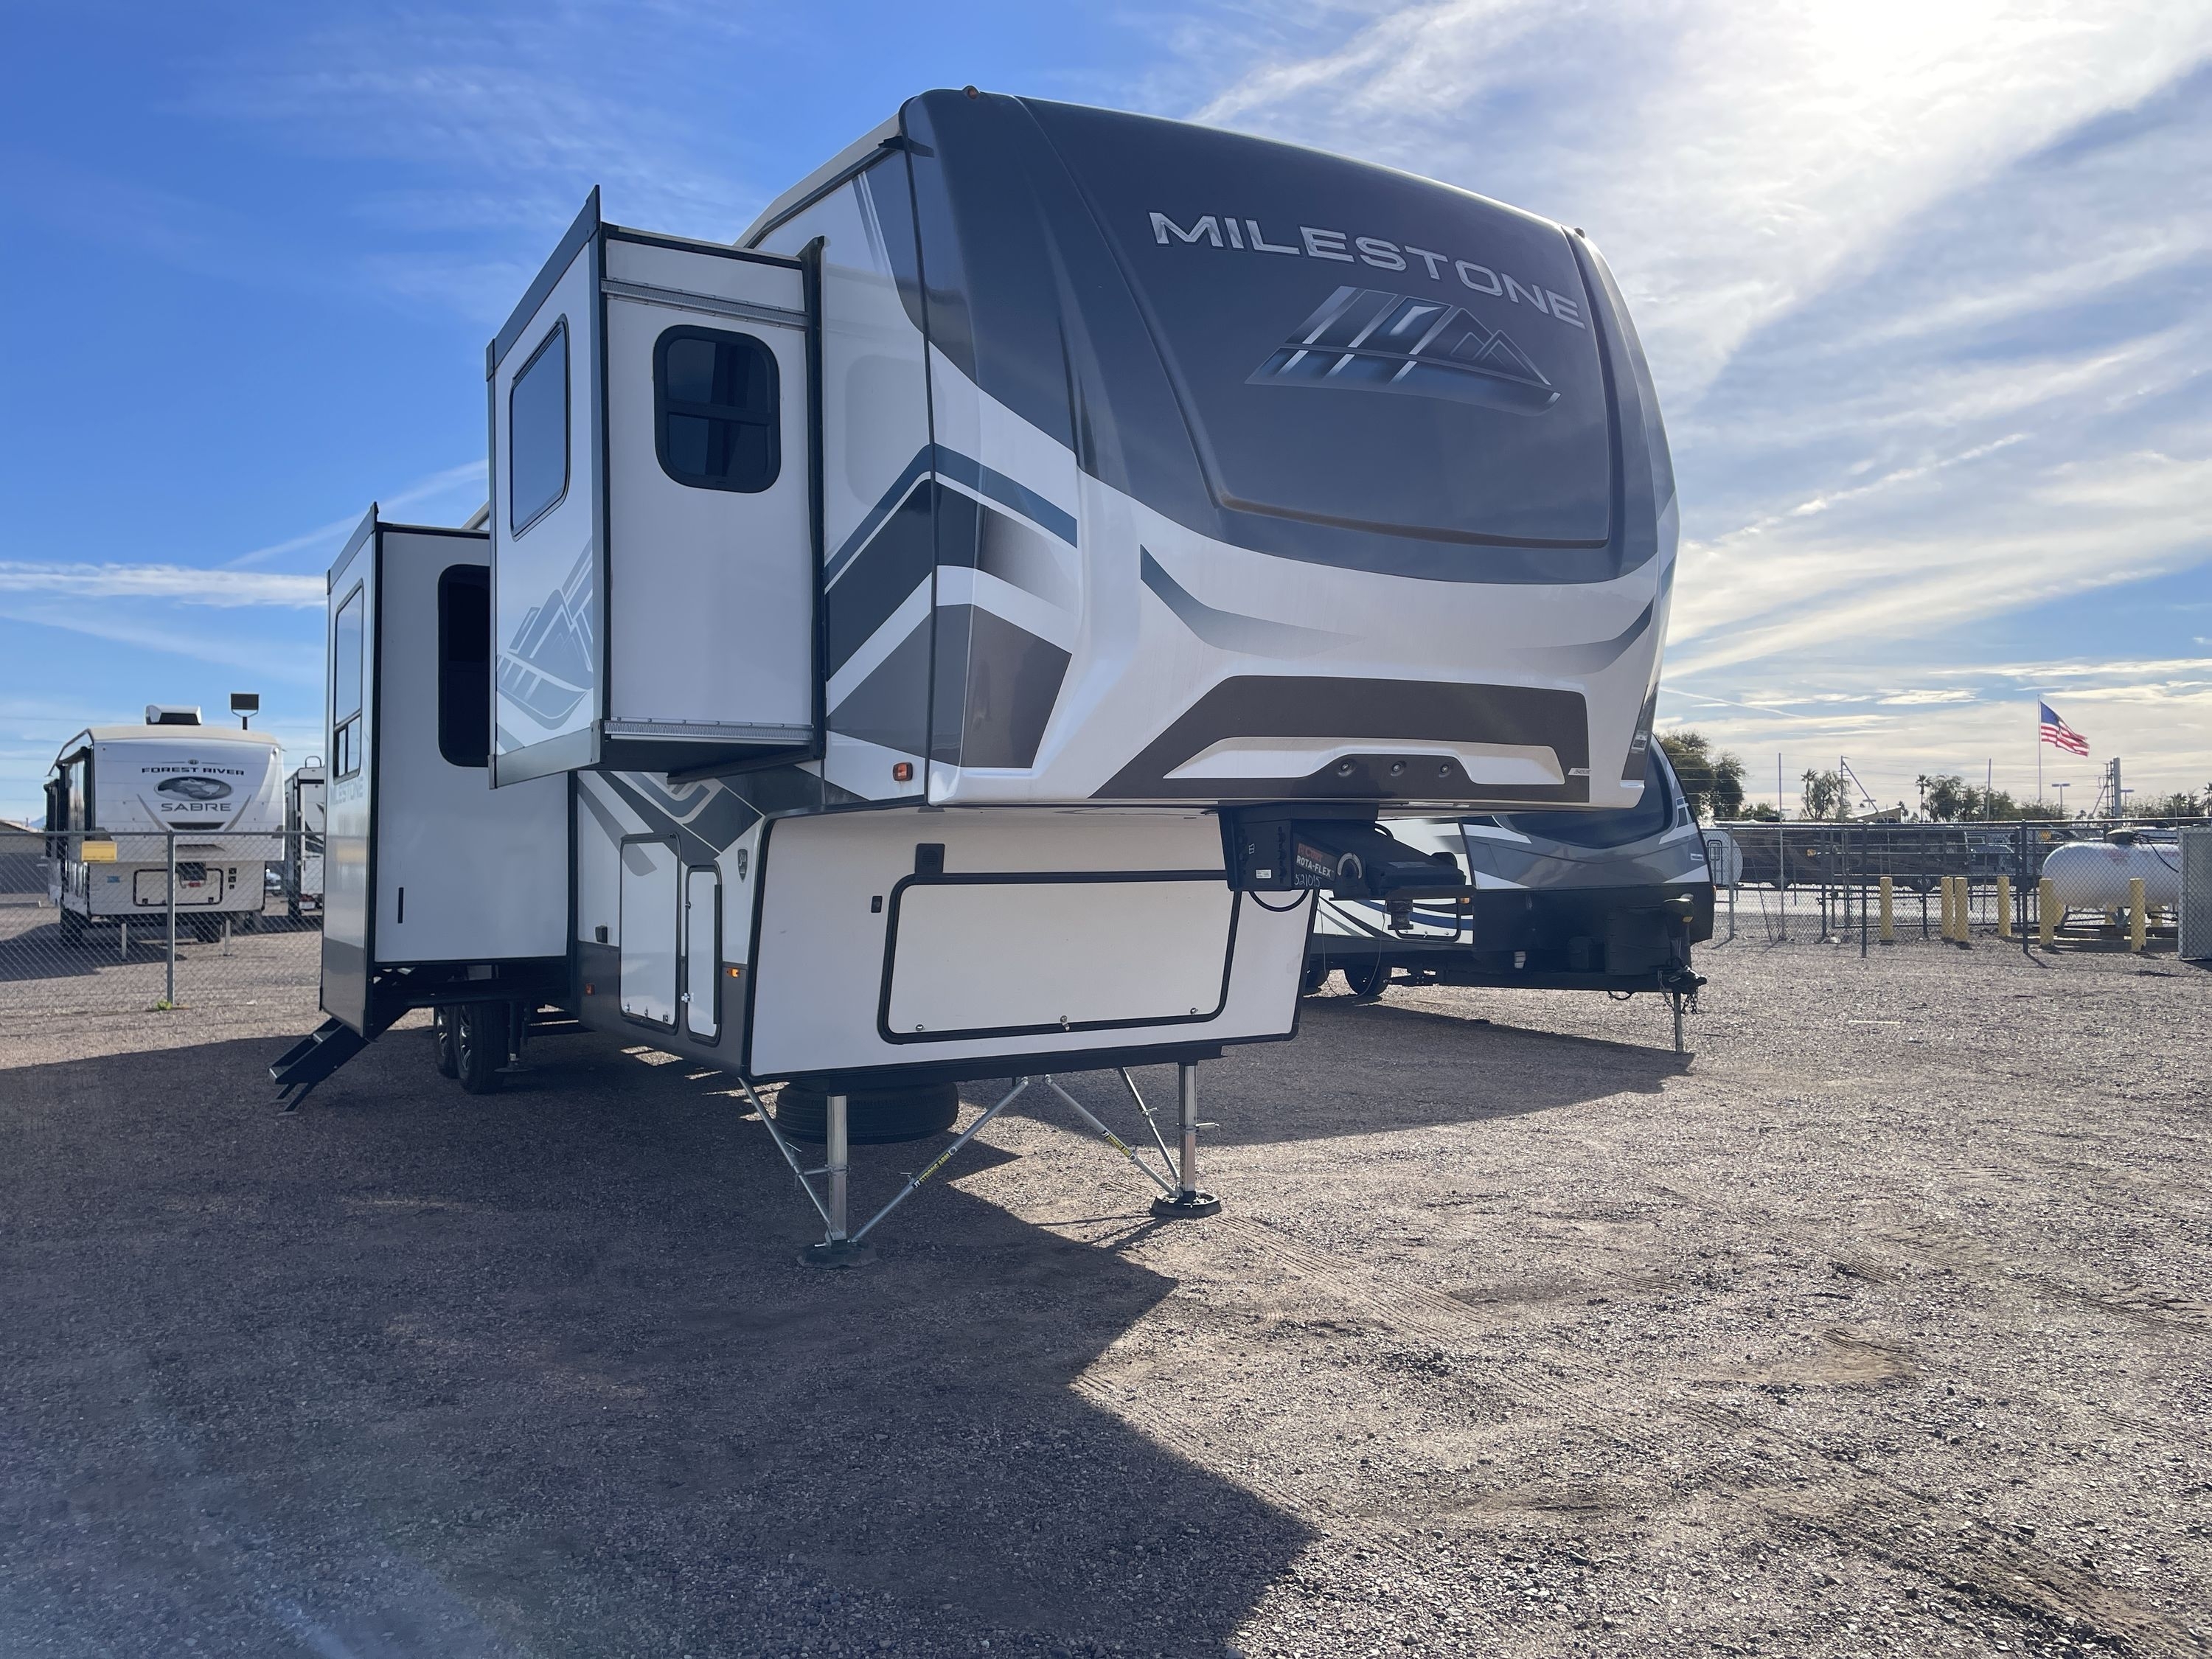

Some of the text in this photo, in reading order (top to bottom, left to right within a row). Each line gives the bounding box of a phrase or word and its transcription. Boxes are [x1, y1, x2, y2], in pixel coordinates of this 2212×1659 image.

[1149, 211, 1587, 330] MILESTONE
[203, 768, 245, 776] RIVER
[161, 803, 232, 812] SABRE
[919, 1163, 940, 1183] STRONG
[937, 1152, 950, 1166] ARM
